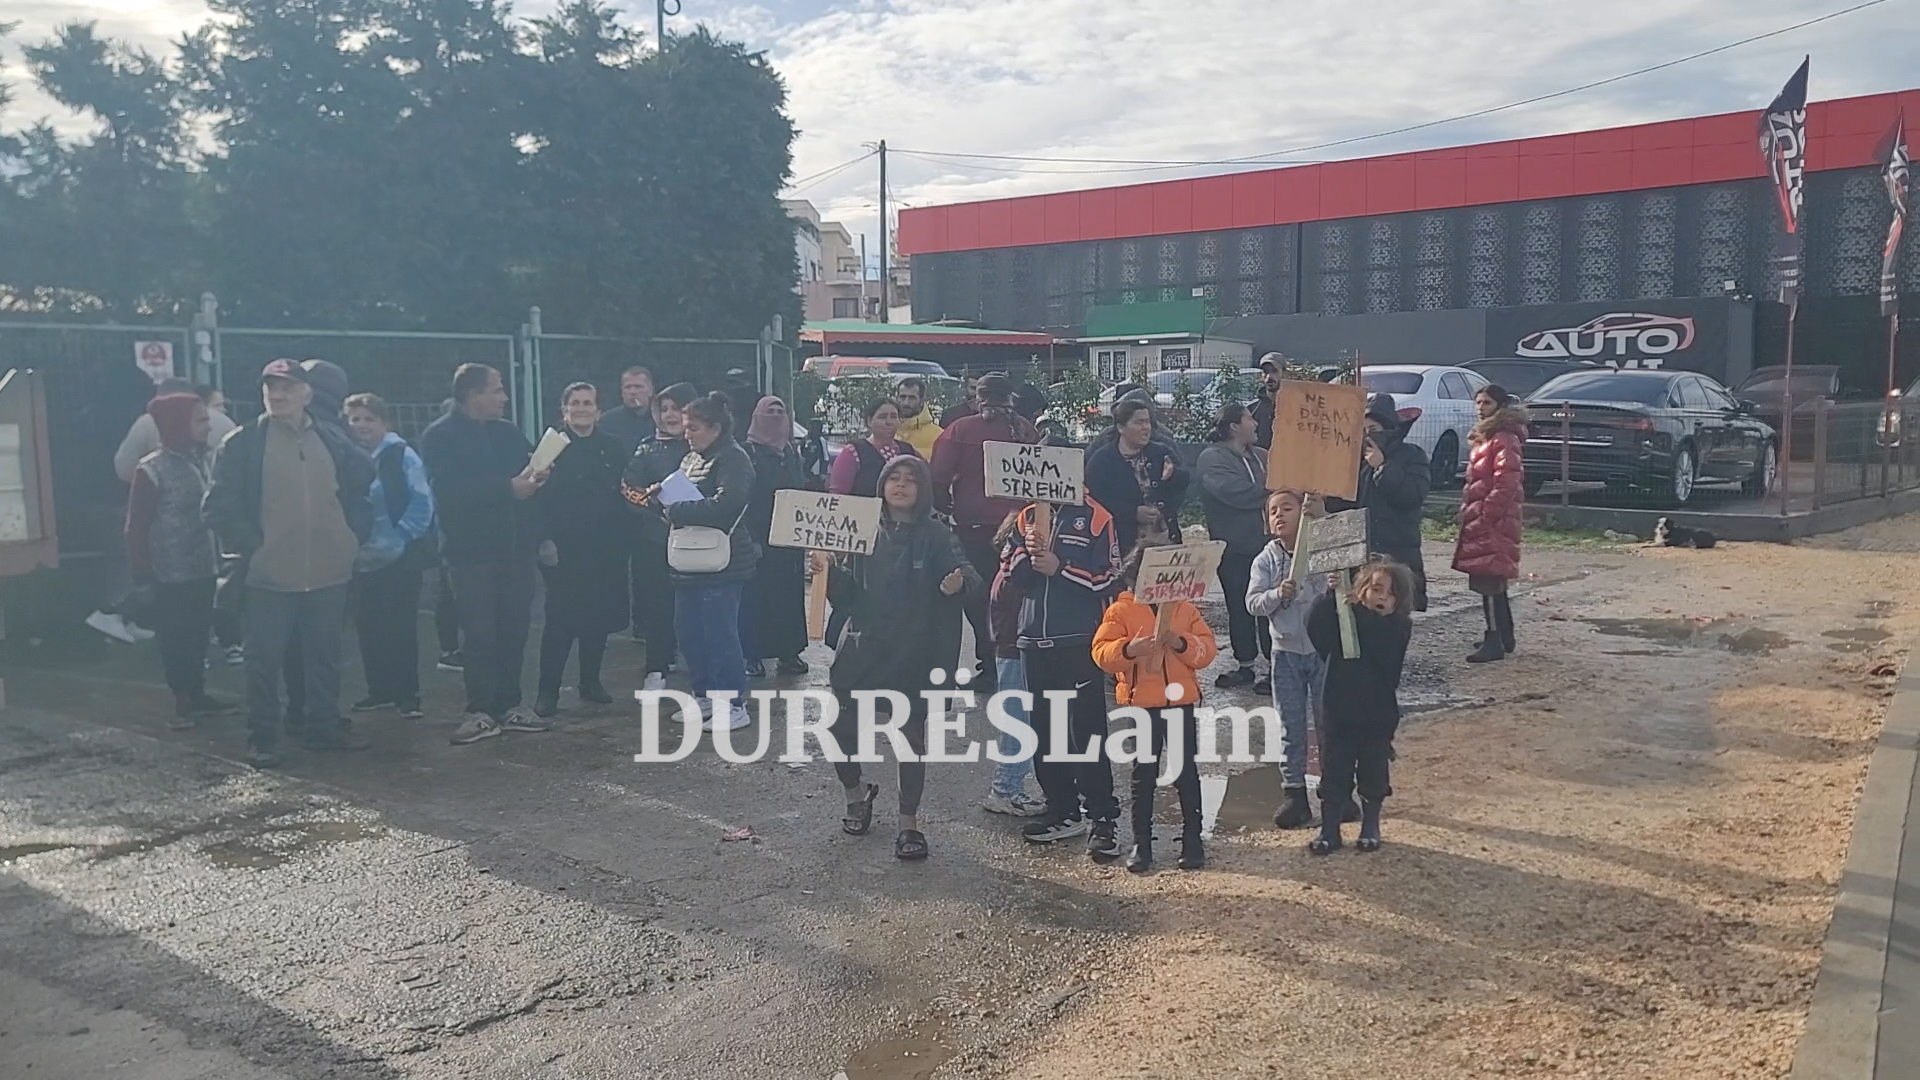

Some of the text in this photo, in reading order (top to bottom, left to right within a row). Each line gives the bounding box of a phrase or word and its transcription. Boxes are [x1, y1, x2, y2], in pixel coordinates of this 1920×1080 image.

[1515, 328, 1679, 357] AUTO
[1305, 393, 1326, 409] NE
[1019, 446, 1042, 458] NE
[816, 497, 840, 511] NE
[1169, 551, 1192, 566] NE
